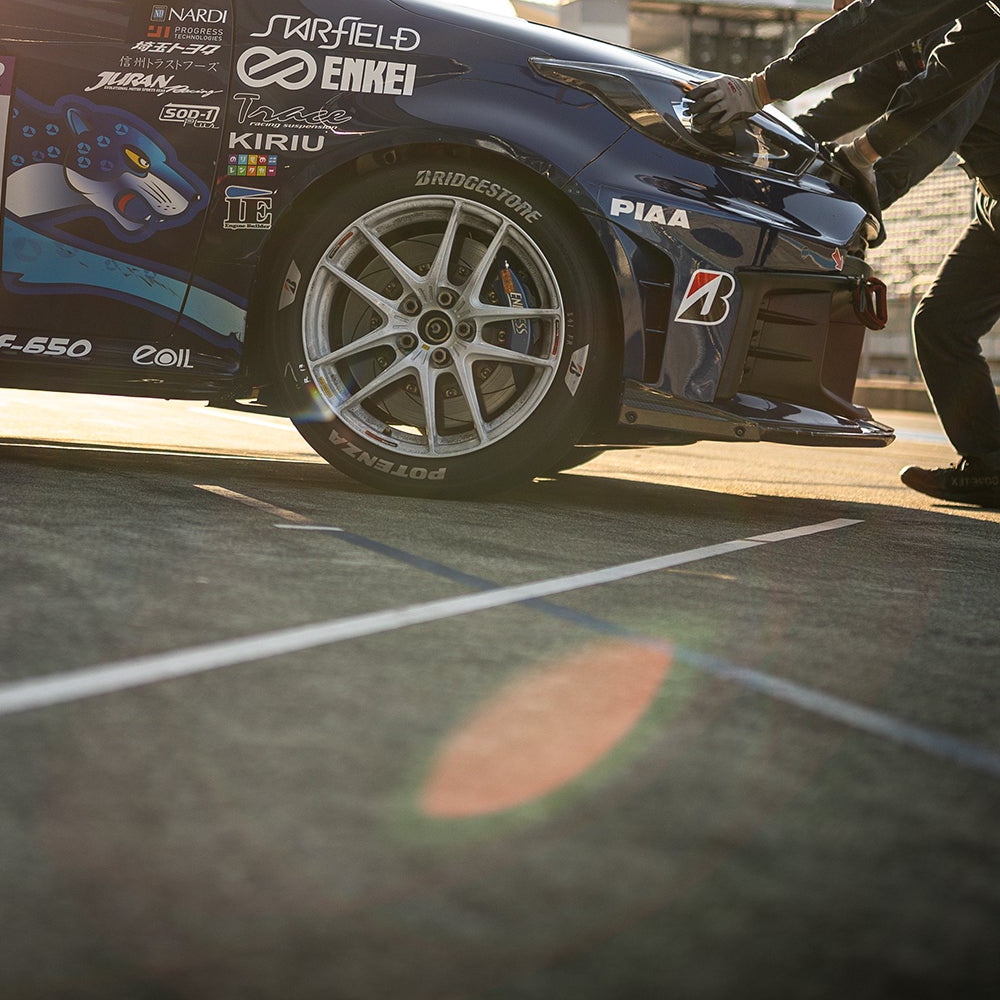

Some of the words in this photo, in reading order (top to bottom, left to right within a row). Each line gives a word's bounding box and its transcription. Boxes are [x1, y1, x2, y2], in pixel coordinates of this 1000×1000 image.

[168, 7, 228, 24] NARDI
[174, 26, 224, 36] PROGRESS
[174, 33, 223, 42] TECHNOLOGIES
[250, 14, 421, 52] STARFIELD
[119, 55, 220, 72] 信州トラストフーズ
[84, 71, 175, 92] JURAN
[157, 84, 224, 98] Racing
[321, 55, 417, 96] ENKEI
[164, 108, 213, 121] SOD-1
[233, 92, 352, 125] Trace
[249, 121, 281, 129] racing
[283, 122, 338, 130] suspension
[228, 132, 325, 152] KIRIU
[415, 170, 543, 223] BRIDGESTONE
[610, 198, 690, 229] PIAA
[328, 429, 447, 480] POTENZA
